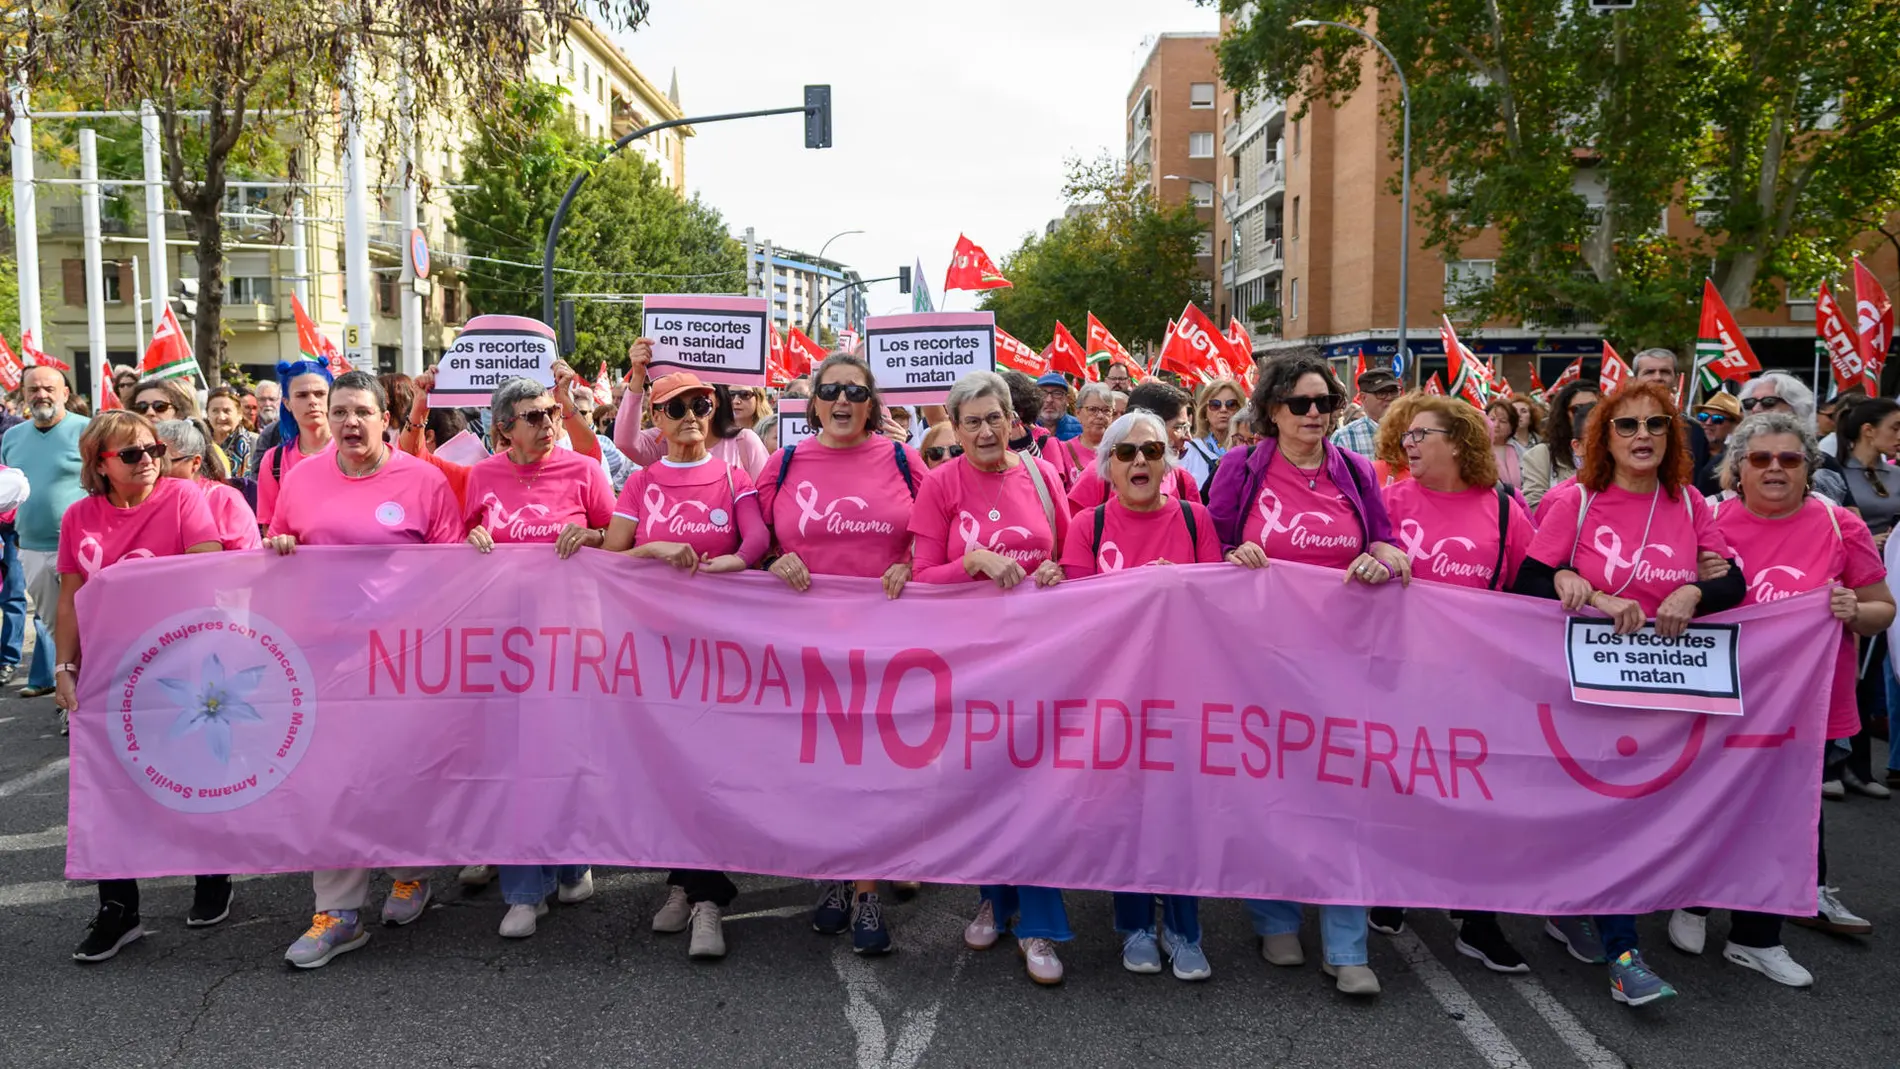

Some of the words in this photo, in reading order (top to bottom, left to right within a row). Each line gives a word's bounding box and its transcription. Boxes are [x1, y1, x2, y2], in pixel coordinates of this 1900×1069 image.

[654, 317, 683, 331] Los
[687, 319, 752, 335] recortes
[348, 329, 359, 344] 5
[660, 334, 679, 347] en
[683, 333, 745, 350] sanidad
[880, 338, 909, 353] Los
[914, 335, 980, 351] recortes
[1177, 316, 1219, 360] UGT
[479, 340, 547, 354] recortes
[450, 357, 470, 370] en
[475, 354, 540, 370] sanidad
[678, 349, 726, 365] matan
[886, 355, 906, 368] en
[910, 350, 974, 366] sanidad
[1013, 354, 1041, 370] Sevilla
[906, 369, 956, 384] matan
[827, 511, 895, 535] Amama
[1291, 524, 1358, 549] Amama
[158, 619, 224, 648] Mujeres
[228, 620, 257, 639] con
[1585, 629, 1623, 646] Los
[1629, 632, 1716, 649] recortes
[141, 646, 160, 664] de
[259, 634, 299, 683] Cáncer
[1593, 650, 1619, 665] en
[1625, 649, 1708, 668] sanidad
[1620, 666, 1686, 684] matan
[291, 687, 304, 707] de
[120, 665, 145, 752] Asociación
[368, 626, 643, 697] NUESTRA
[661, 635, 792, 708] VIDA
[799, 646, 953, 770] NO
[964, 698, 1175, 772] PUEDE
[1200, 702, 1494, 801] ESPERAR
[276, 711, 304, 759] Mama
[144, 765, 194, 800] Sevilla
[198, 774, 258, 799] Amama
